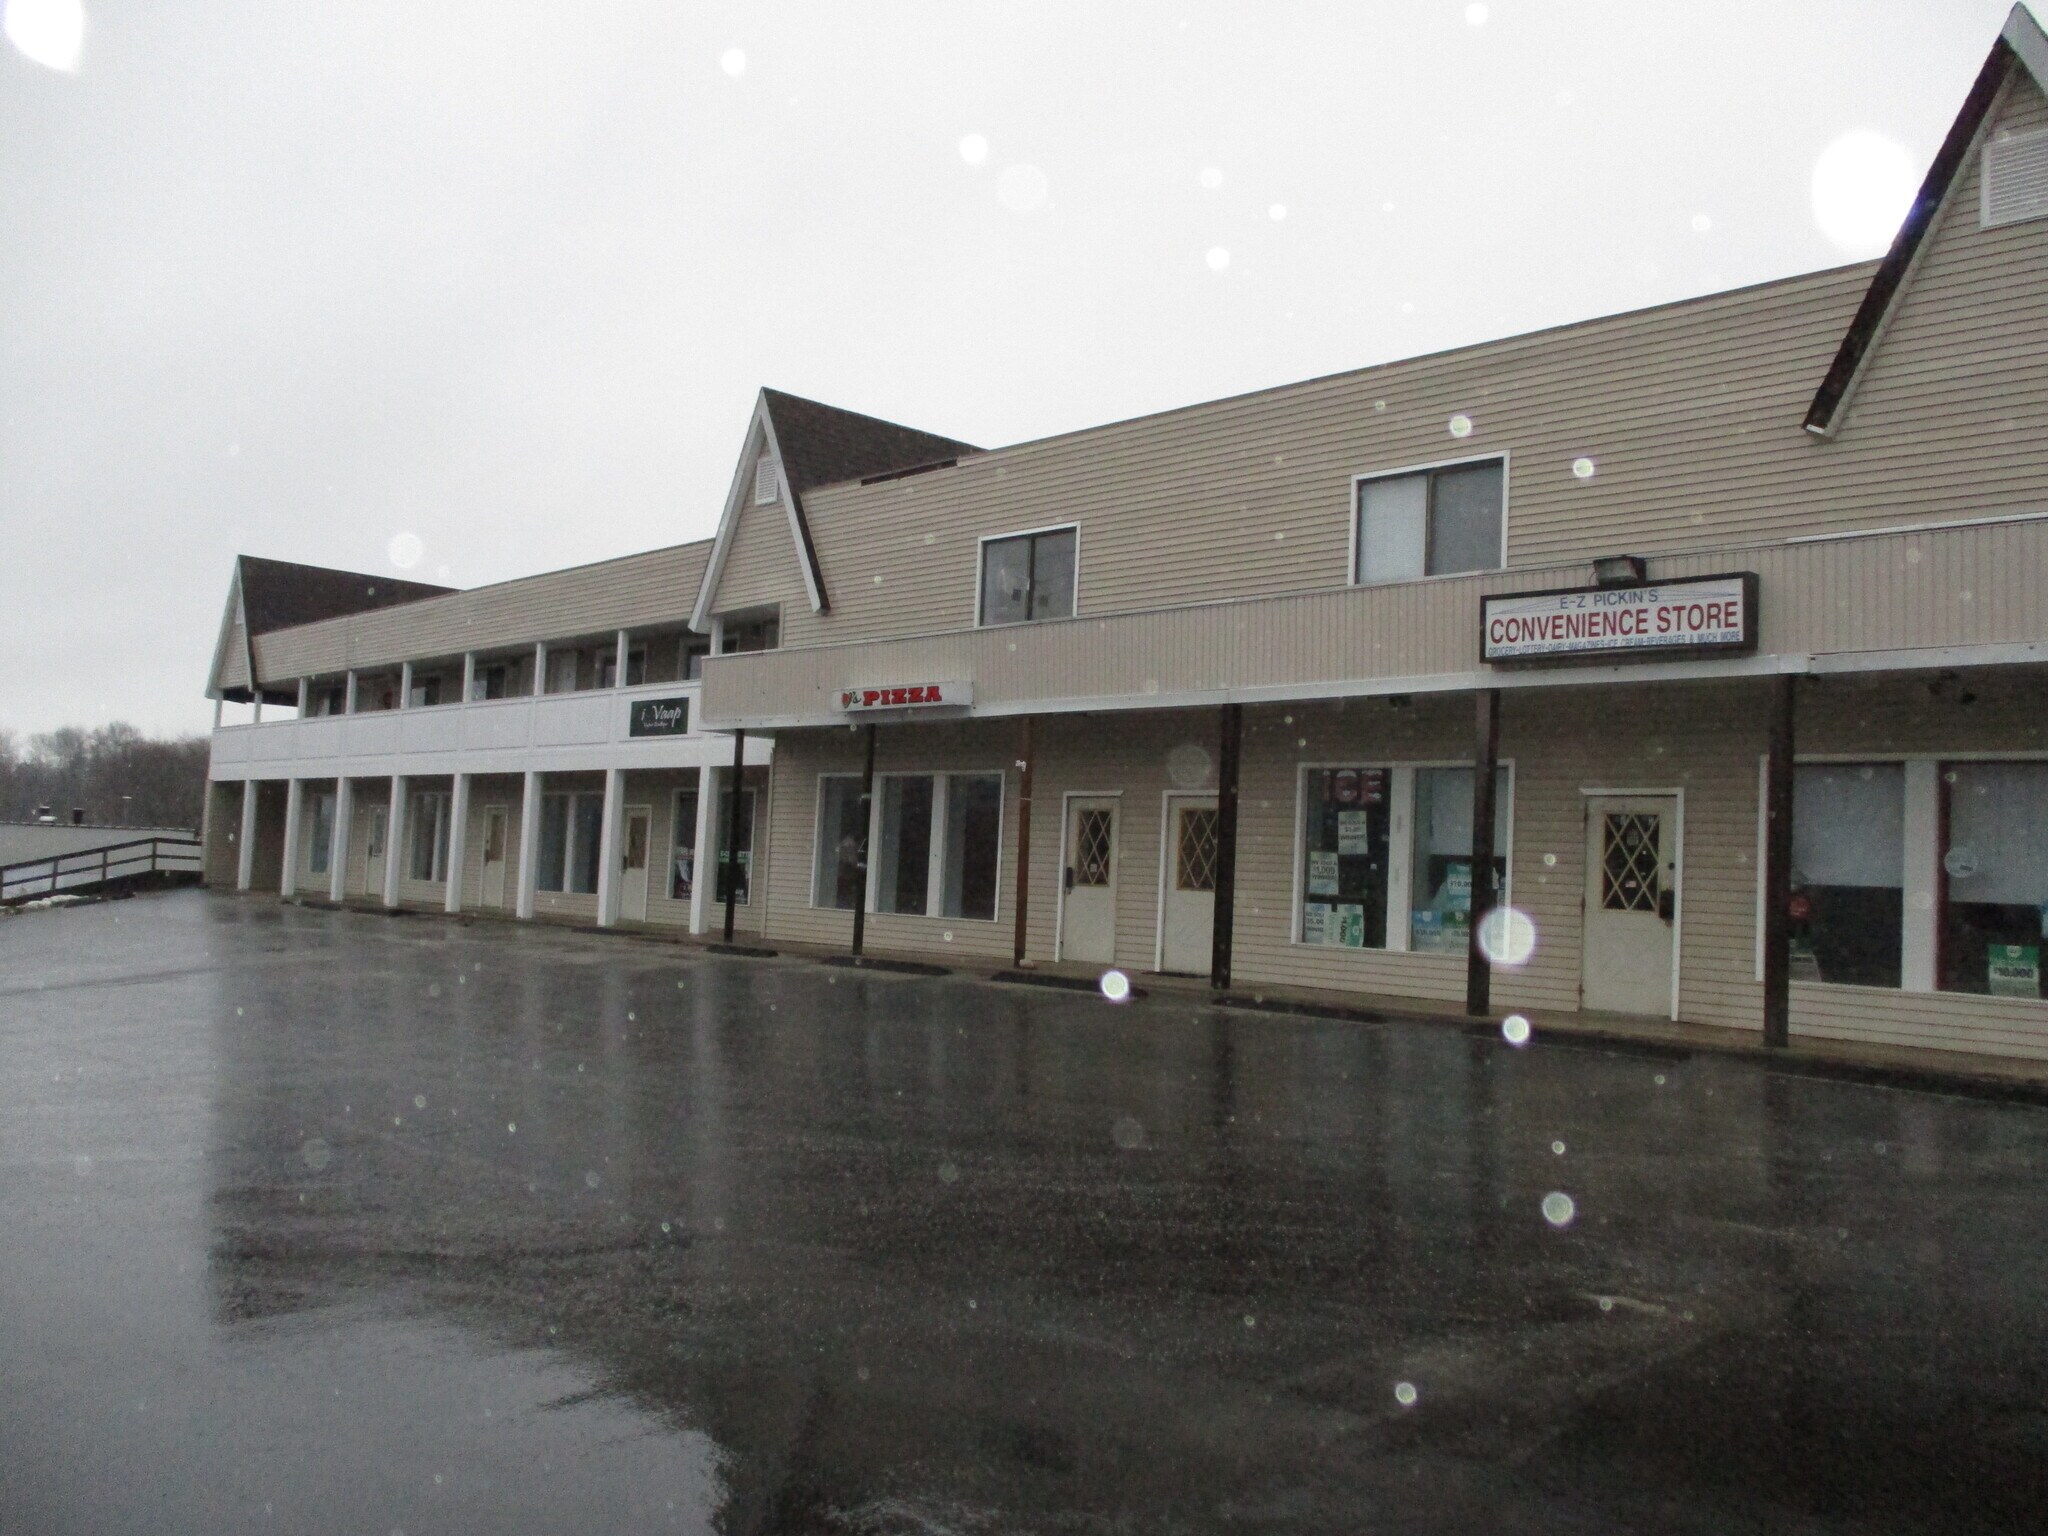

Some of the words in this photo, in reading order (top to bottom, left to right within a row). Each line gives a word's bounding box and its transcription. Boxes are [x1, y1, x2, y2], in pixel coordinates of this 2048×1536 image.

[1560, 595, 1586, 609] E-Z
[1593, 589, 1659, 607] PICKIN'S
[1490, 608, 1649, 644] CONVENIENCE
[1656, 601, 1738, 633] STORE
[863, 686, 942, 706] PIZZA
